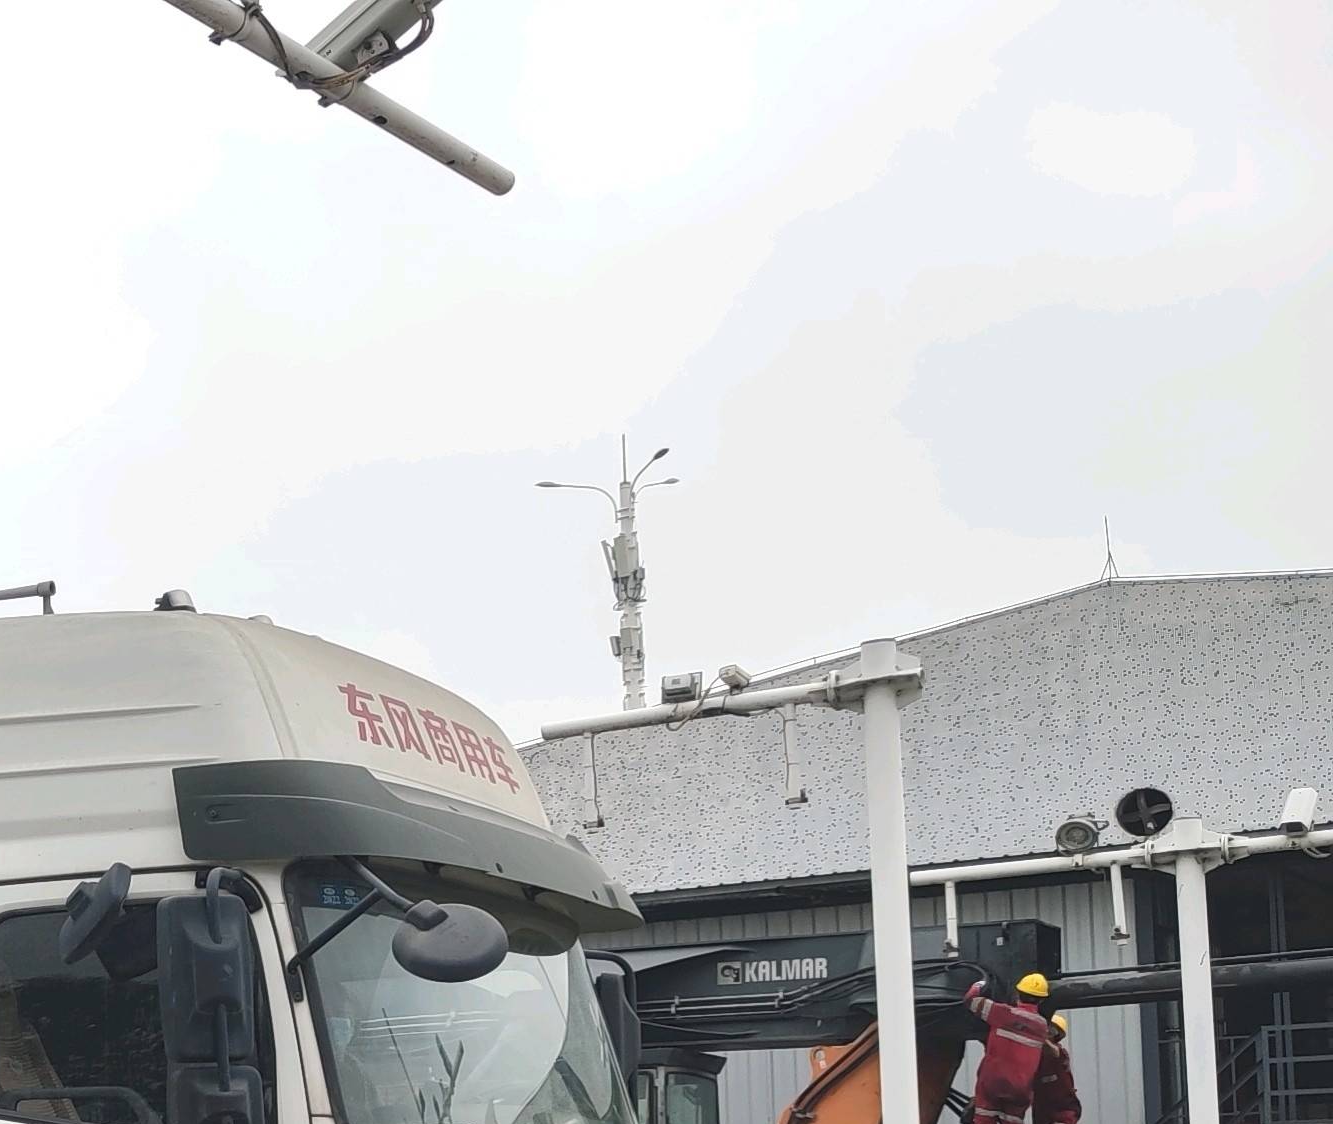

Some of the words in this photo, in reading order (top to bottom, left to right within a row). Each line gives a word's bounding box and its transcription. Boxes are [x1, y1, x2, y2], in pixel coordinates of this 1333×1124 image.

[338, 683, 520, 794] 东风商用车
[744, 958, 828, 983] KALMAR
